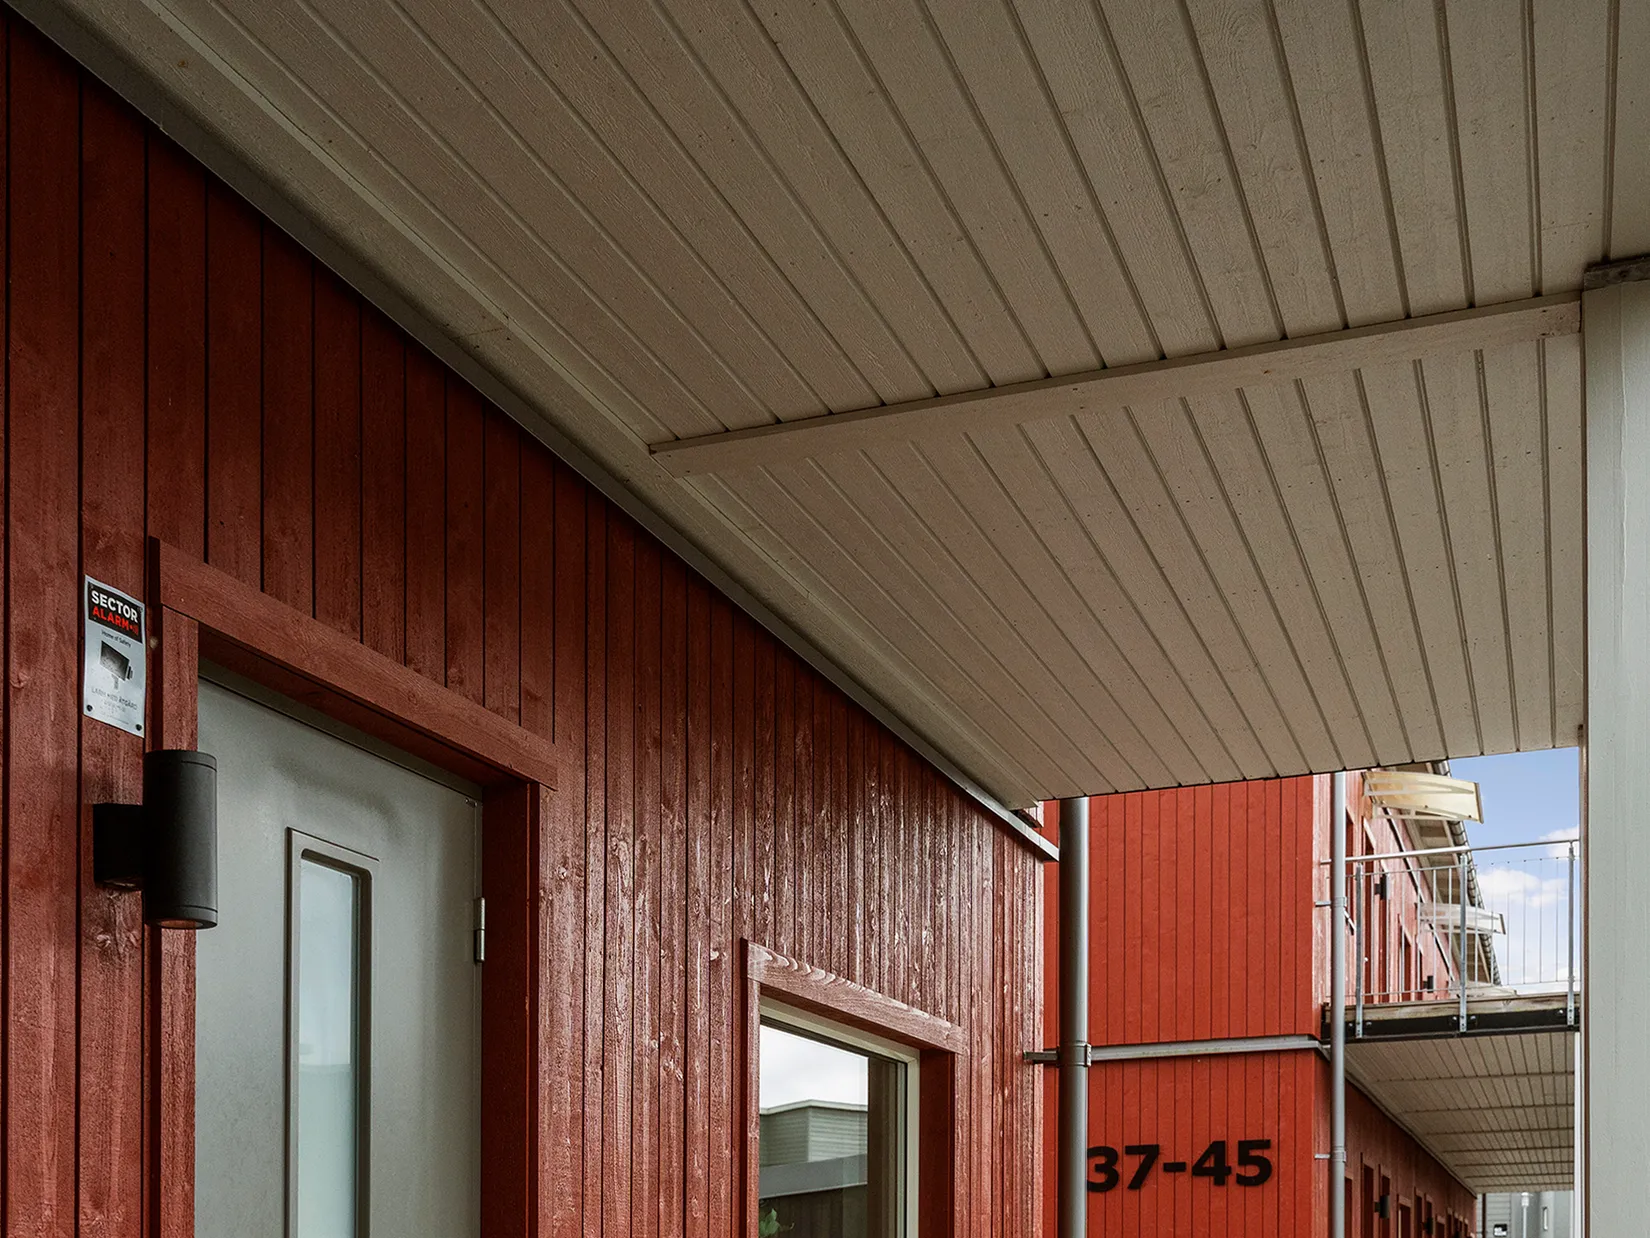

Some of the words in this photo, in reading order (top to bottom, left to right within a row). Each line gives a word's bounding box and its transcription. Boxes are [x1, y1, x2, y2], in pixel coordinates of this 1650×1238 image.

[91, 590, 138, 623] SECTOR
[93, 605, 129, 631] ALARM
[1086, 1139, 1273, 1193] 37-45
